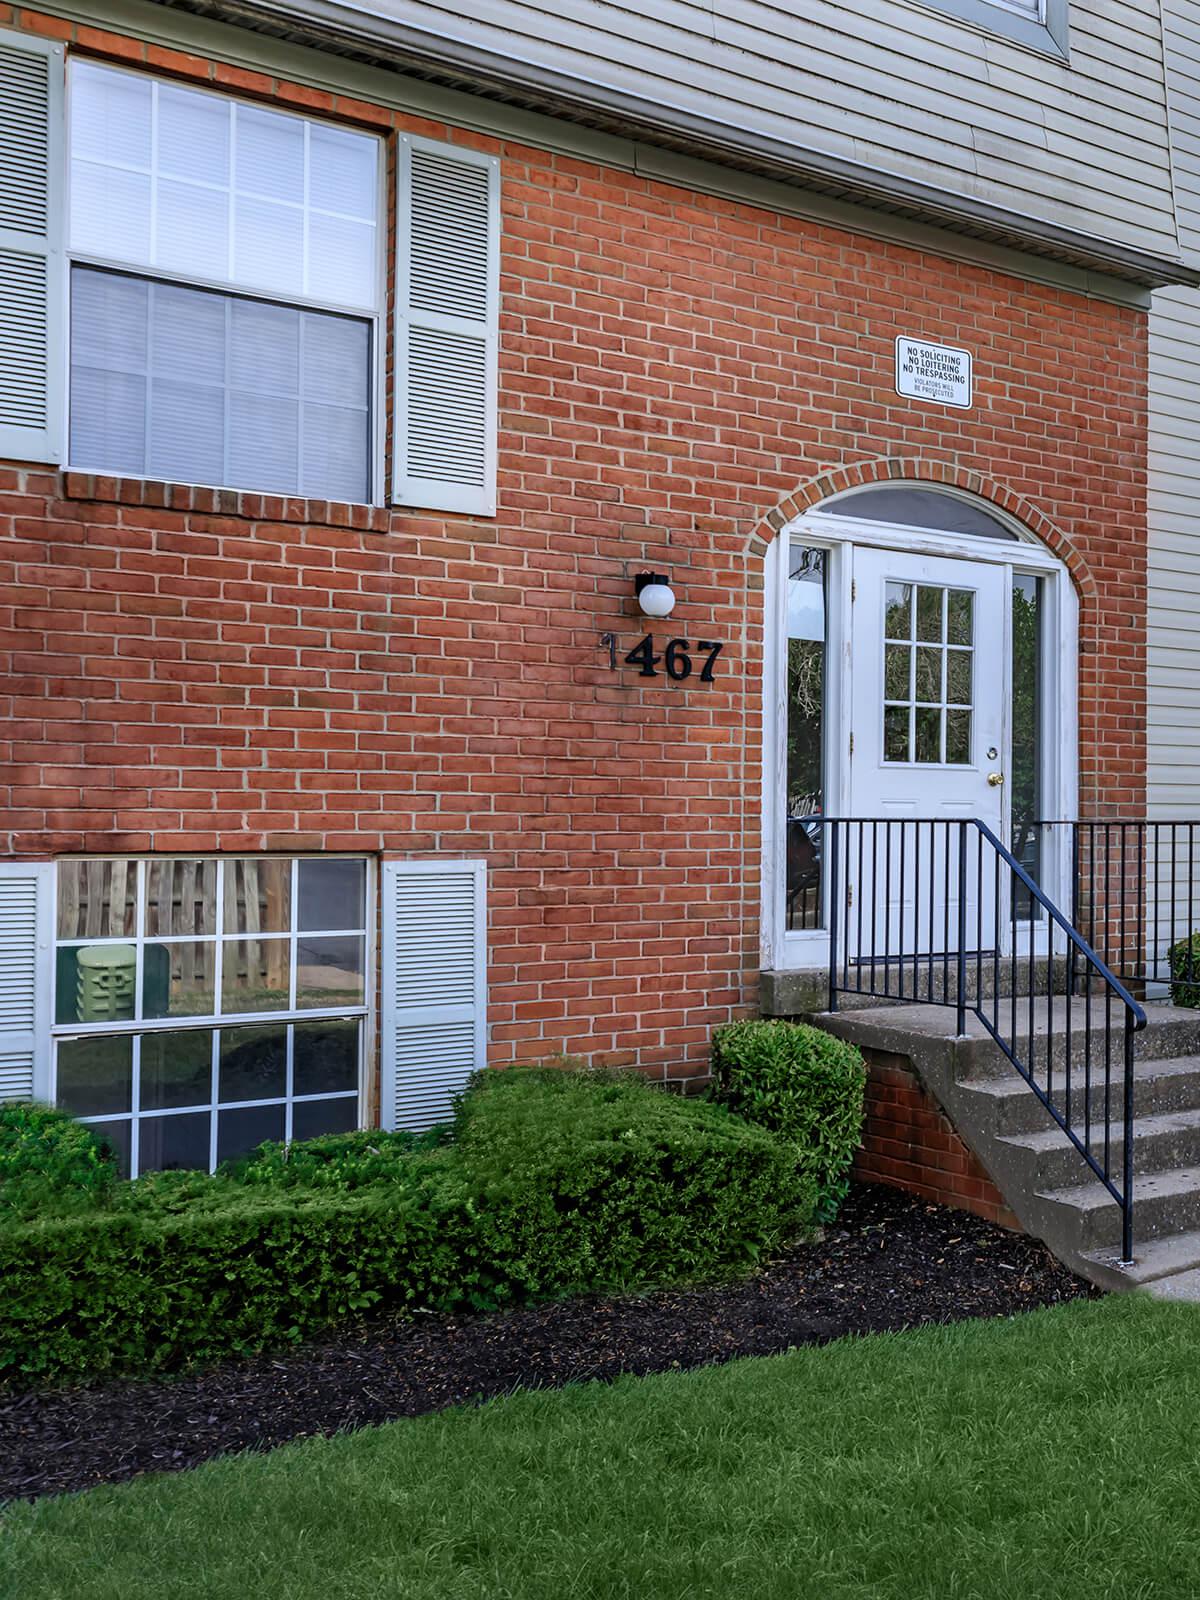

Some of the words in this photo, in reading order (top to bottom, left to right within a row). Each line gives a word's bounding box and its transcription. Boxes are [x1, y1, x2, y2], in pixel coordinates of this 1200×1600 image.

[907, 347, 918, 356] NO
[920, 350, 960, 365] SOLICITING
[903, 364, 913, 373] NO
[916, 367, 965, 384] TRESPASSING
[909, 357, 919, 365] NO
[922, 359, 959, 374] LOITERING
